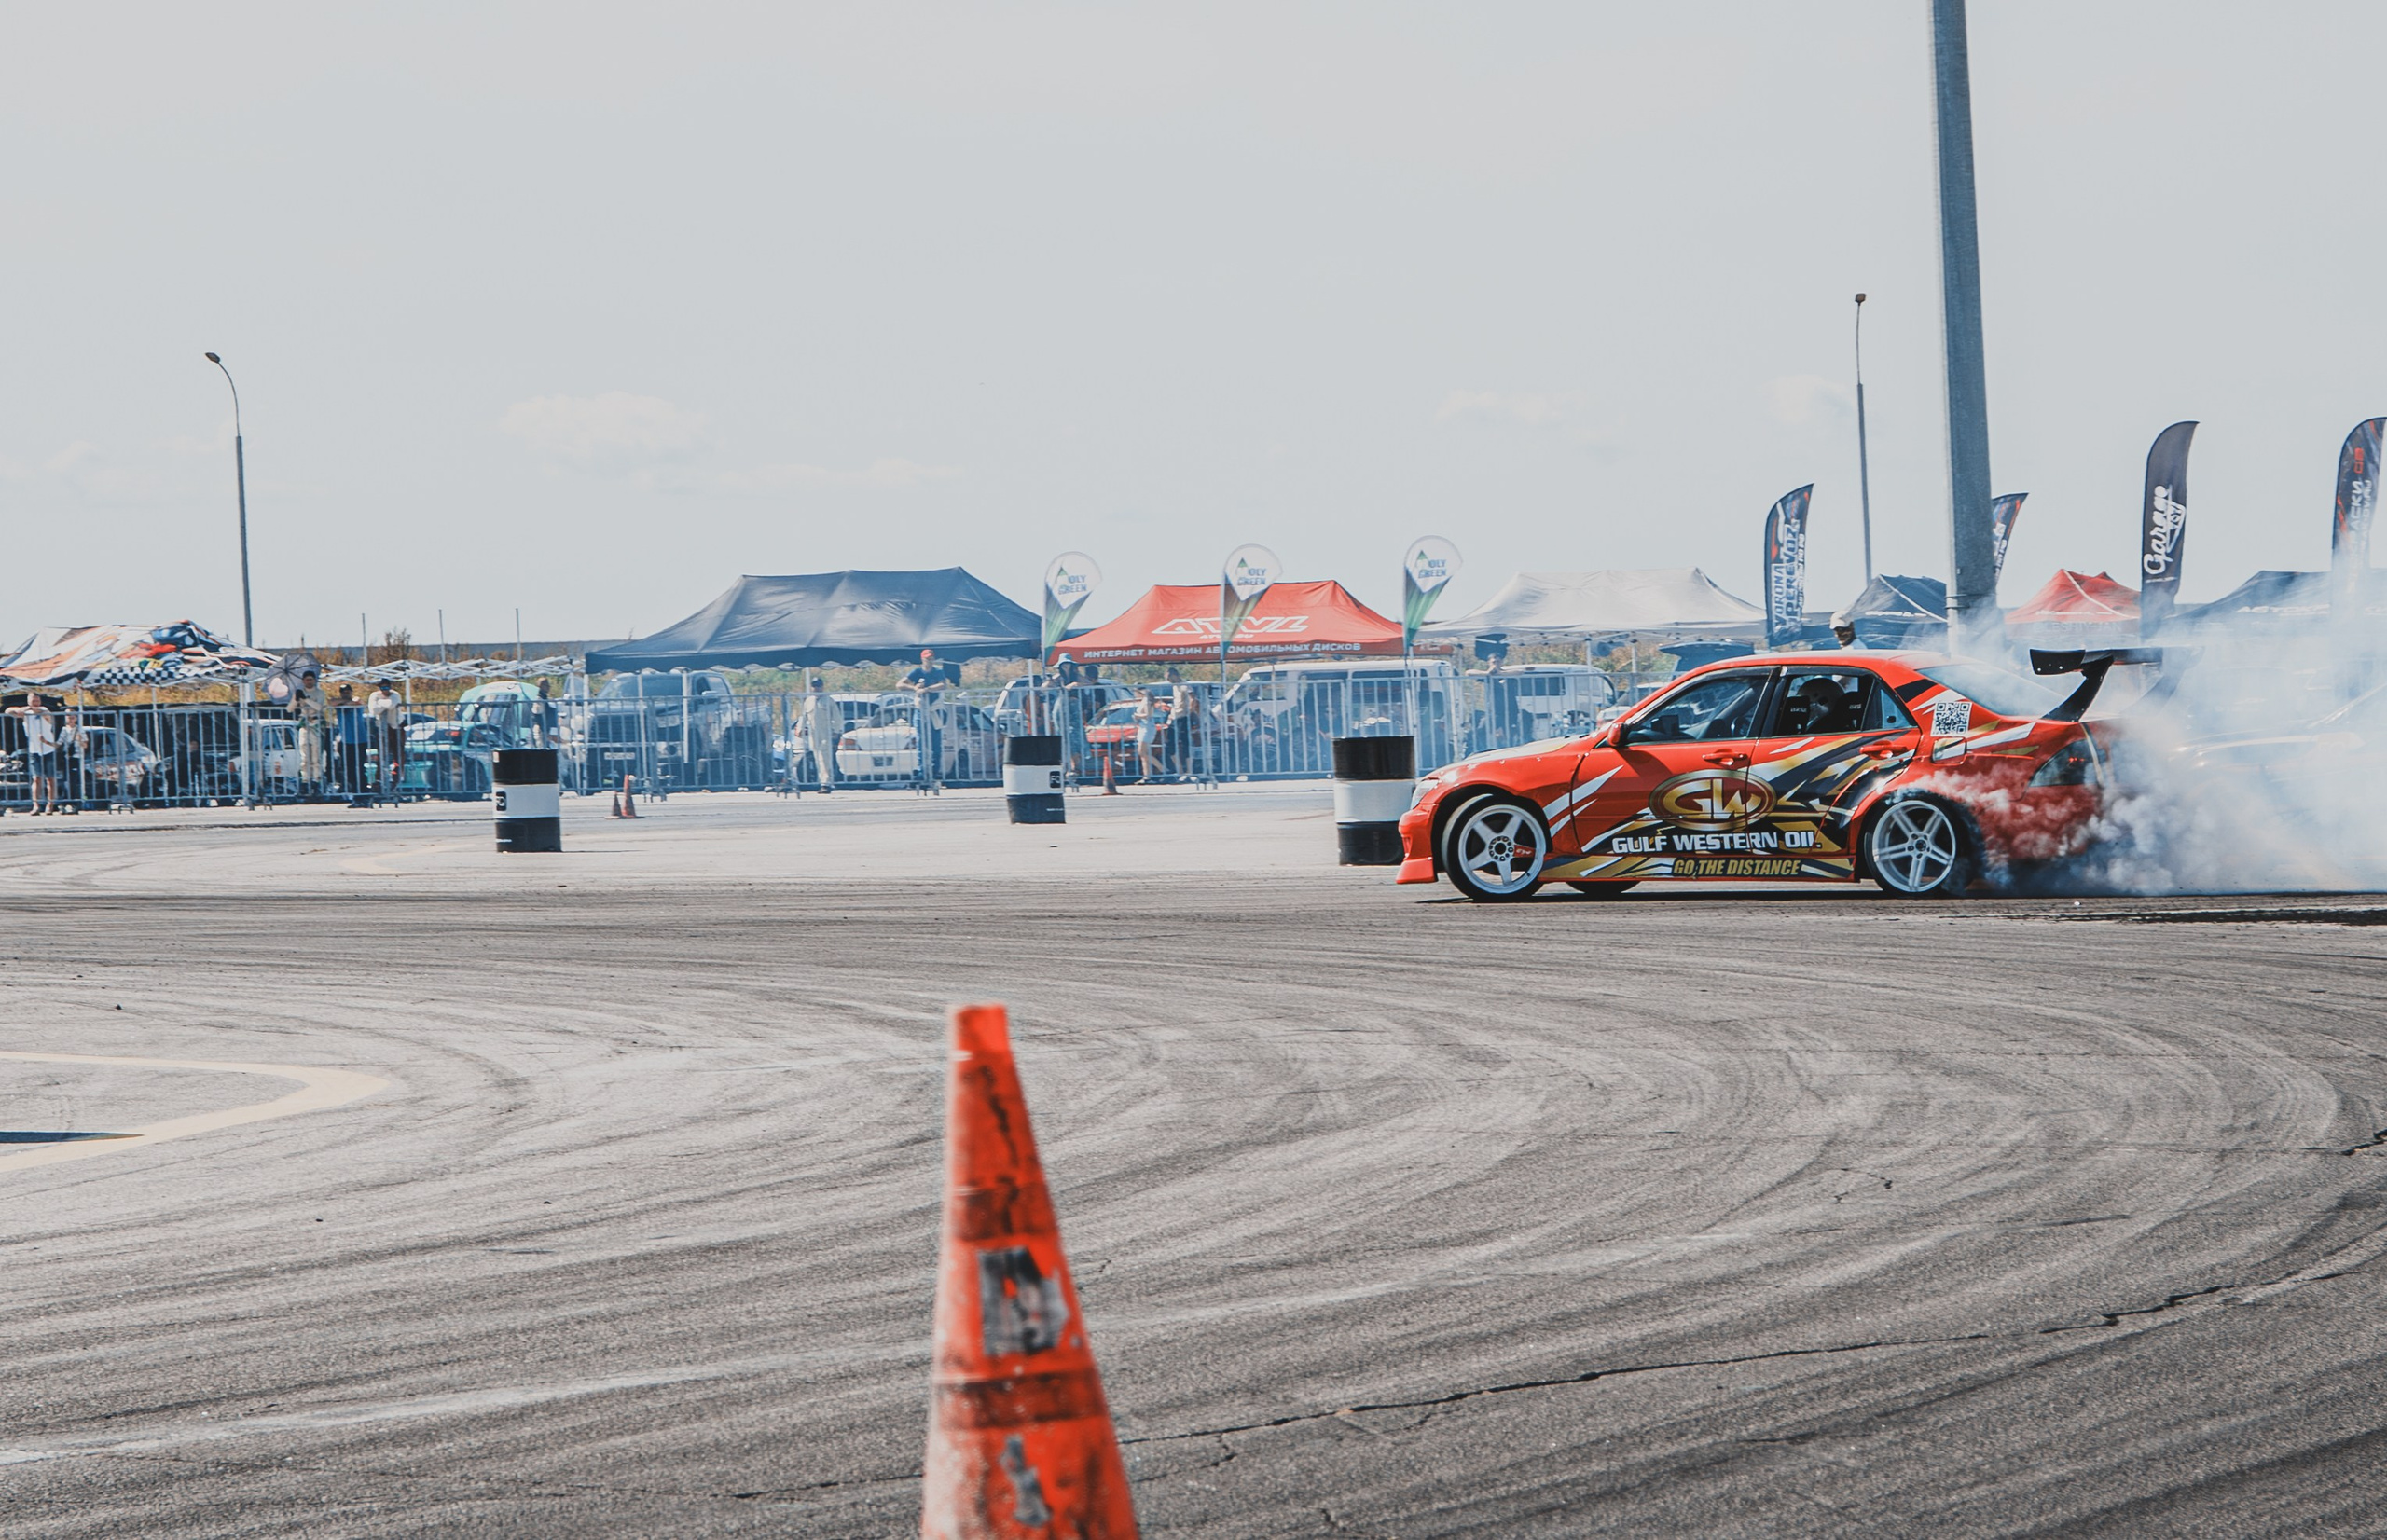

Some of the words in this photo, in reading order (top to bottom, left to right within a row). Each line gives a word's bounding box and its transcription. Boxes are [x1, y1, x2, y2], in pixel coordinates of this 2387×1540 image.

[1774, 564, 1787, 628] VORONA
[1083, 649, 1145, 658] ИНТЕРНЕТ
[1148, 646, 1202, 656] МАГАЗИН
[1205, 643, 1310, 654] АВОМОБИЛЬНЫХ
[1312, 642, 1361, 652] ДИСКОВ
[1611, 835, 1668, 854] GULF
[1673, 832, 1779, 851] WESTERN
[1673, 859, 1697, 875] GO
[1698, 859, 1725, 875] THE
[1727, 859, 1801, 876] DISTANCE
